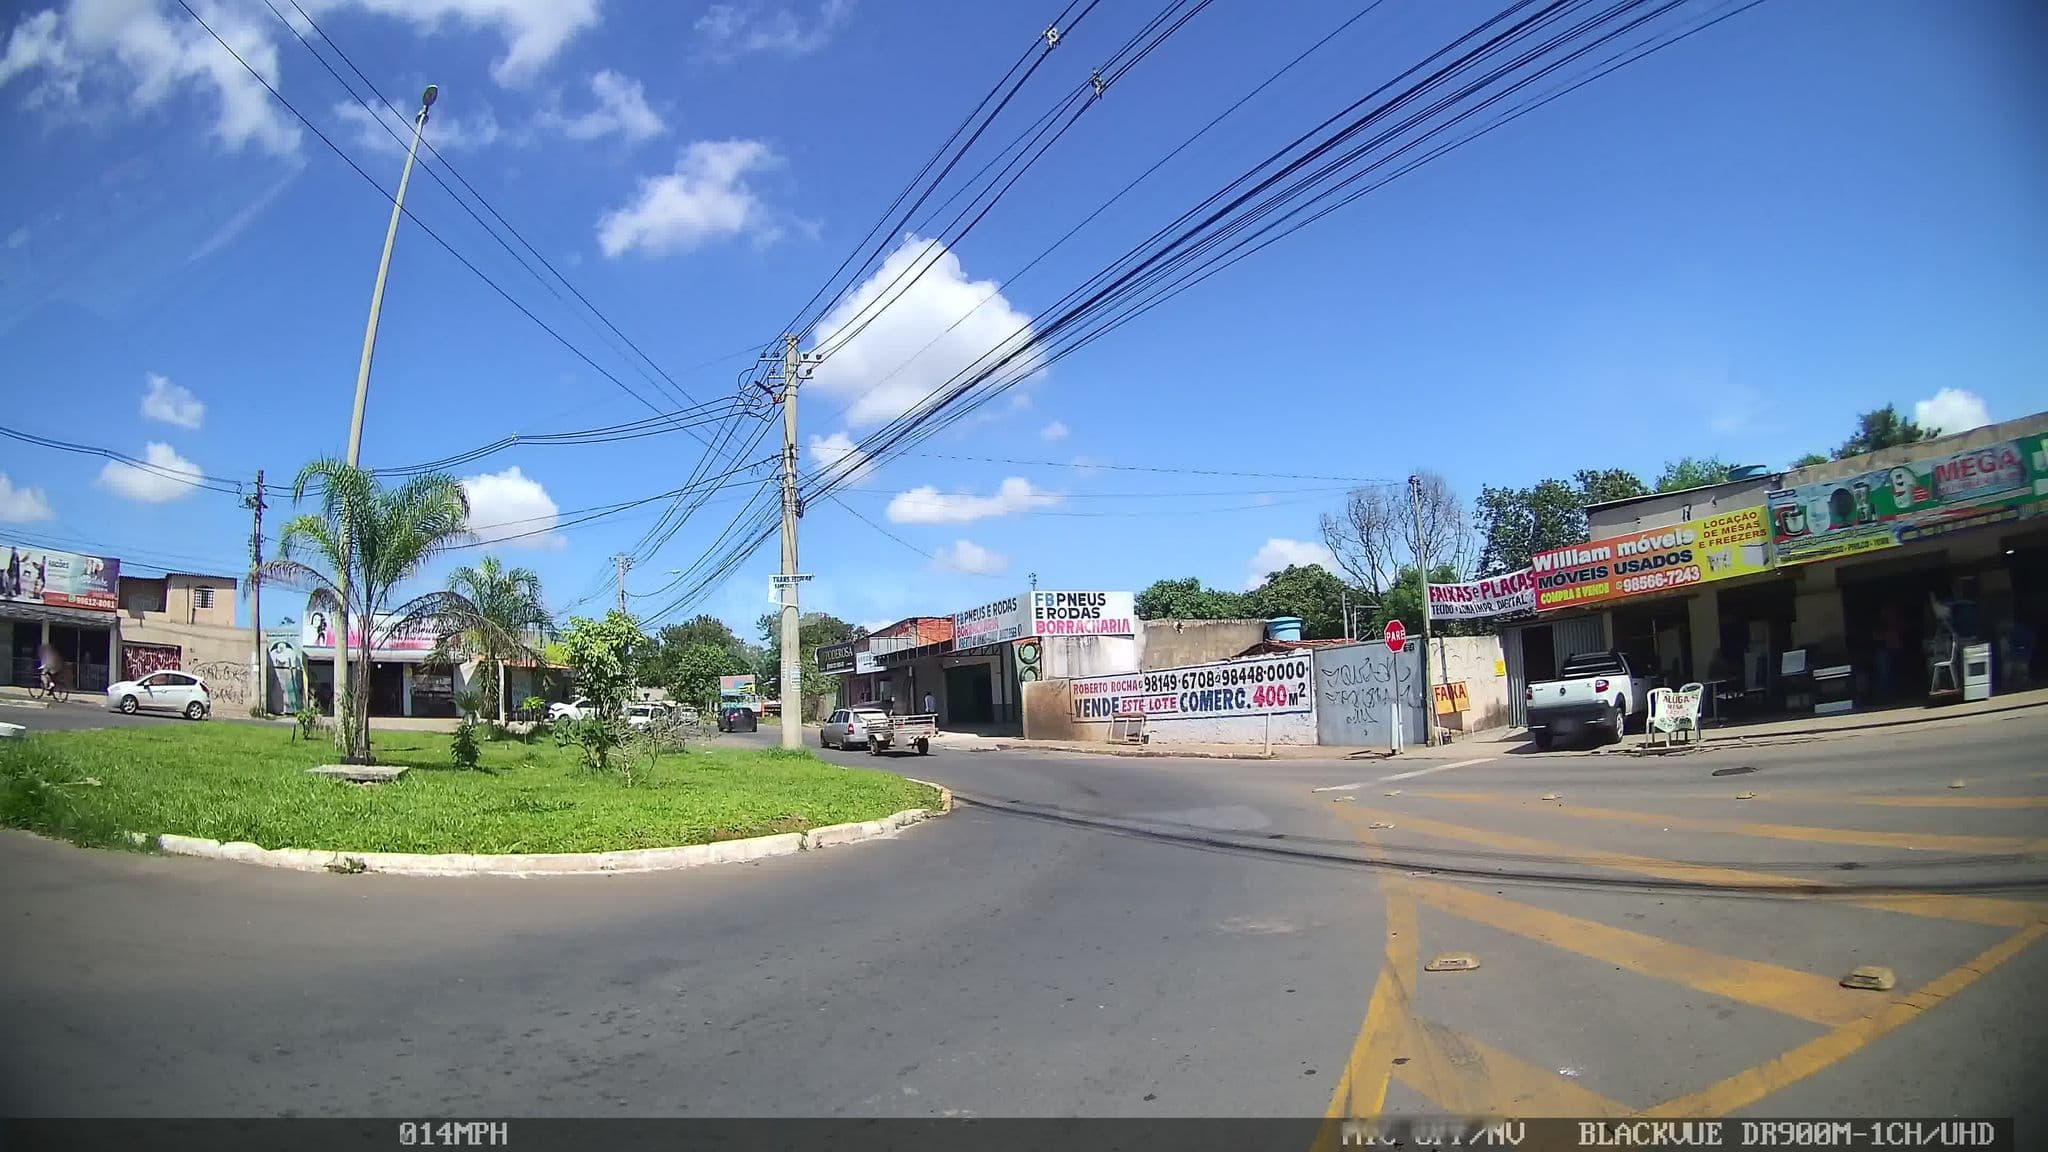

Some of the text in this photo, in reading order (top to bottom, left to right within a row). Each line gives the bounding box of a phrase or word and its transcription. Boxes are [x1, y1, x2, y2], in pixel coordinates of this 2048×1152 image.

[1704, 512, 1757, 529] LOCAÇÃO
[1704, 521, 1760, 539] DE MESAS
[1617, 528, 1695, 557] móveis
[1699, 541, 1706, 549] E
[1709, 529, 1767, 547] FREEZERS
[1538, 550, 1693, 589] MÓVEIS USADOS
[1429, 571, 1535, 603] FAIXAS e PLACAS
[1623, 566, 1700, 593] 98566-7243
[1056, 593, 1106, 606] PNEUS
[1540, 589, 1575, 604] COMPRA
[964, 605, 986, 623] PNEUS
[986, 604, 992, 618] E
[992, 597, 1017, 618] RODAS
[1035, 607, 1101, 620] E RODAS
[1431, 604, 1454, 615] TECIDO
[1035, 619, 1131, 634] BORRACHARIA
[1387, 630, 1405, 642] PARE
[1073, 681, 1108, 695] ROBERTO
[1110, 678, 1138, 692] ROCHA
[1074, 696, 1120, 717] VENDE
[1121, 697, 1144, 713] ESTE
[1149, 696, 1177, 712] LOTE
[1180, 687, 1251, 712] COMERC.
[1253, 684, 1287, 707] 400
